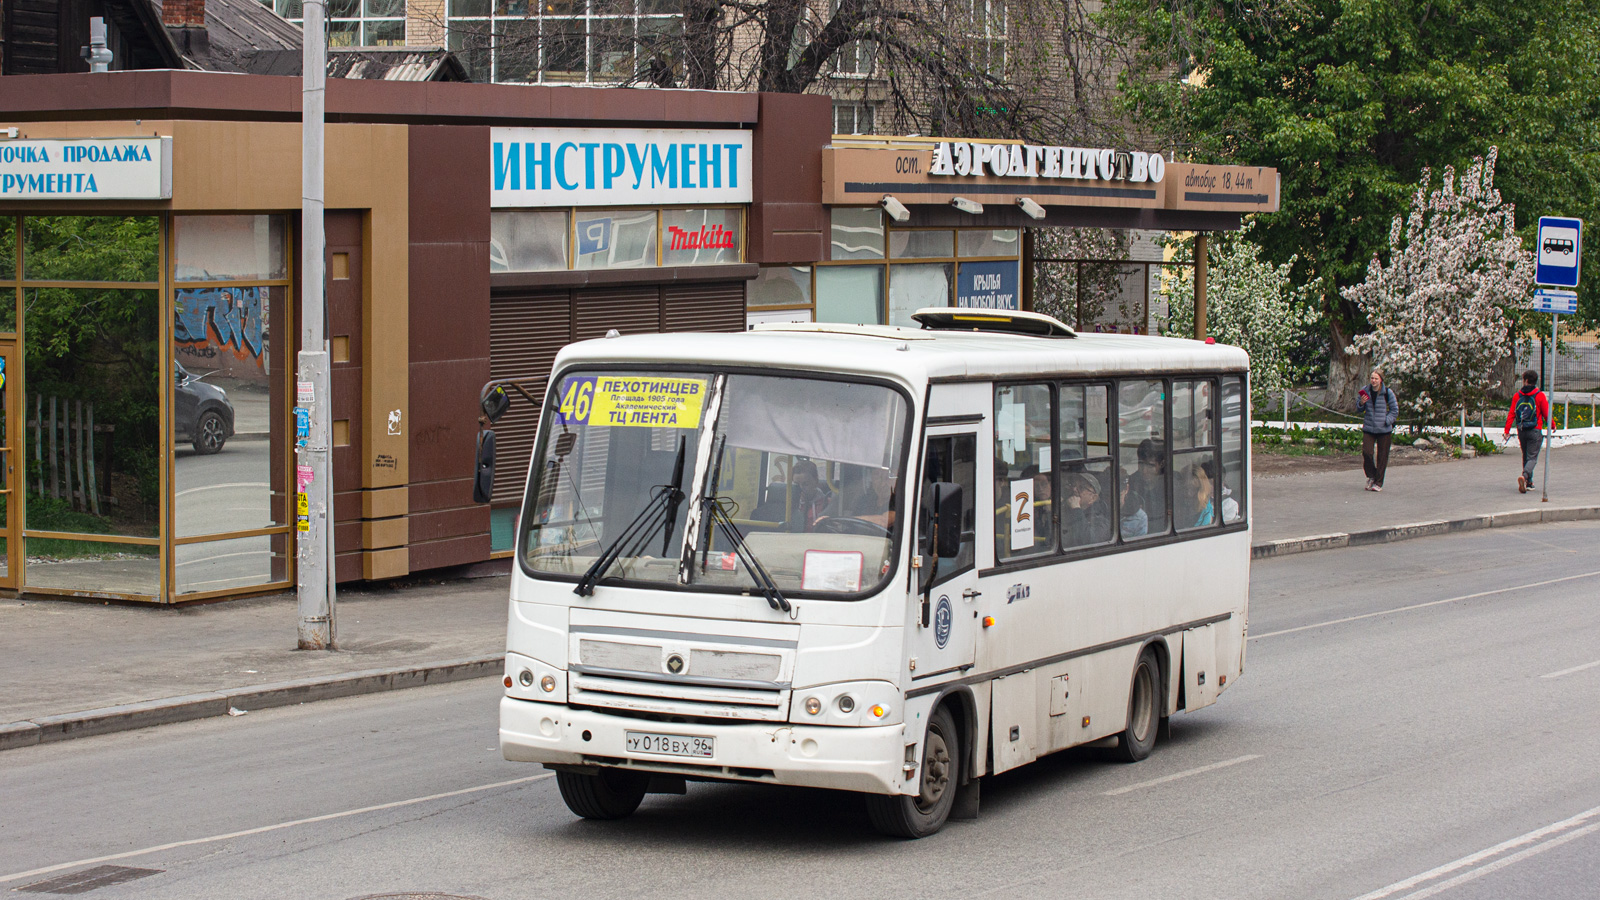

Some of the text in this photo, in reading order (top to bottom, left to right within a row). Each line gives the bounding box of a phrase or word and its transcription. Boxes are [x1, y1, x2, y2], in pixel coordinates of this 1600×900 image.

[0, 144, 152, 163] ОЧКА ПРОДАЖА
[895, 141, 1166, 183] ост. АЭРОАГЕНТСТВО
[493, 141, 743, 191] ИНСТРУМЕНТ
[0, 173, 98, 193] РУМЕНТА
[1184, 168, 1217, 192] автобус
[973, 273, 1001, 291] КРЫЛЬЯ
[958, 296, 969, 309] НА
[970, 291, 996, 310] ЛЮБОЙ
[602, 380, 700, 396] ПЕХОТИНЦЕВ
[559, 380, 593, 422] 46
[610, 394, 645, 403] Площадь
[647, 395, 666, 403] 1905
[615, 402, 677, 411] Академический
[608, 411, 678, 425] ТЦ ЛЕНТА
[693, 738, 708, 751] 96
